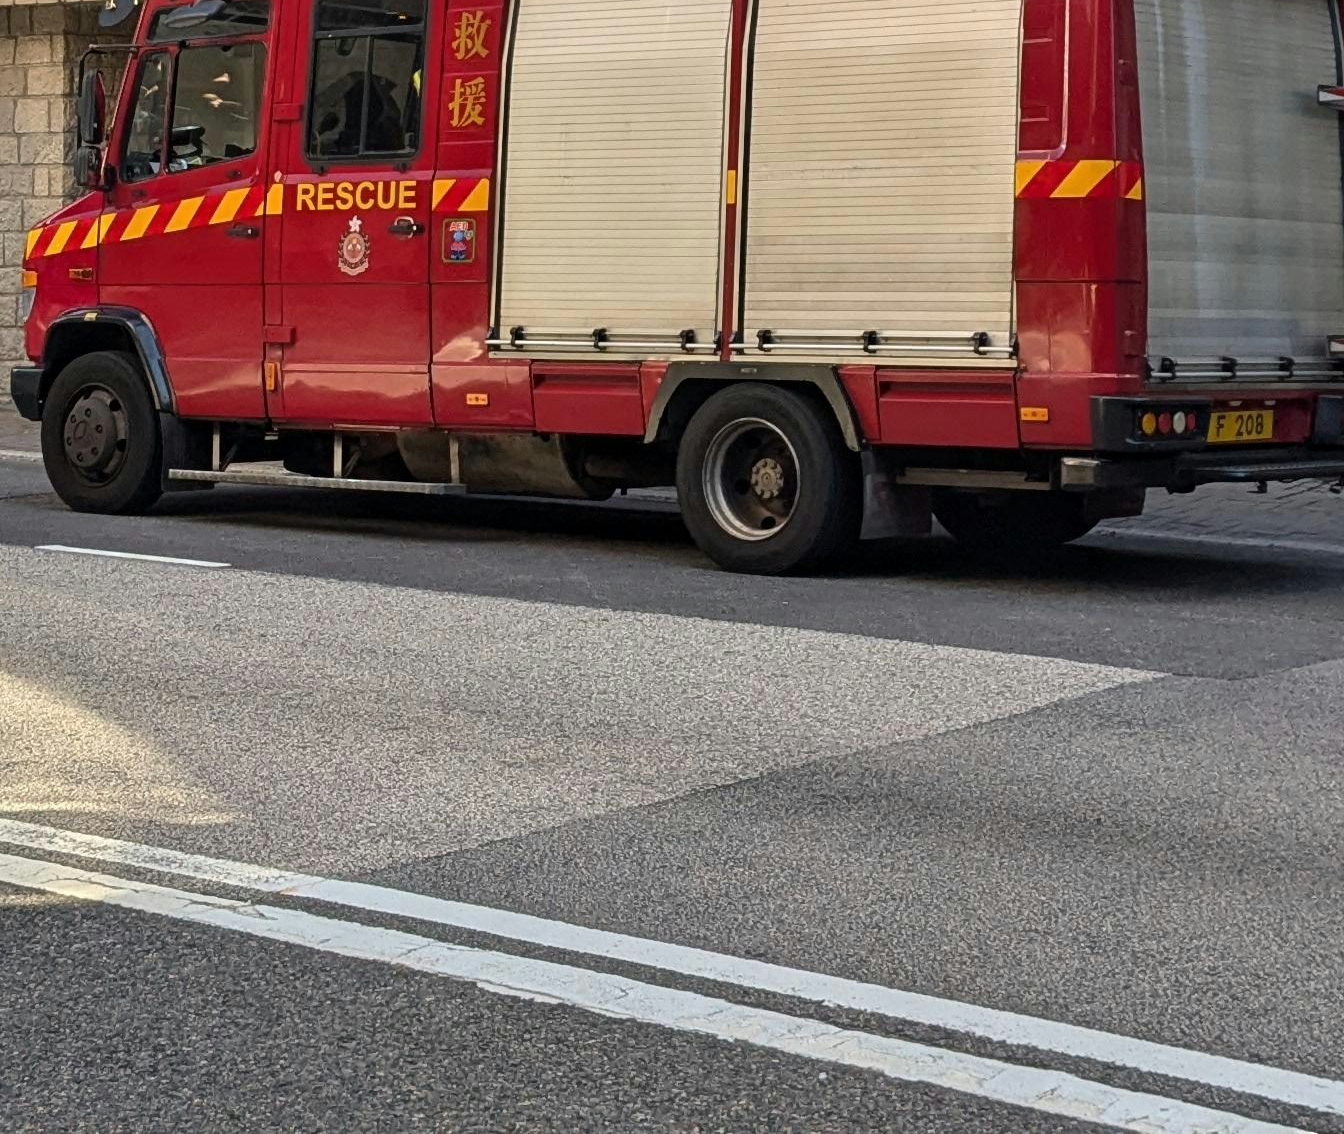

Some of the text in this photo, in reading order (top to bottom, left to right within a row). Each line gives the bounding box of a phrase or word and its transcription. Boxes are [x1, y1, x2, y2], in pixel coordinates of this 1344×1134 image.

[448, 10, 492, 128] 救援
[296, 180, 417, 211] RESCUE
[1216, 412, 1264, 438] F 208
